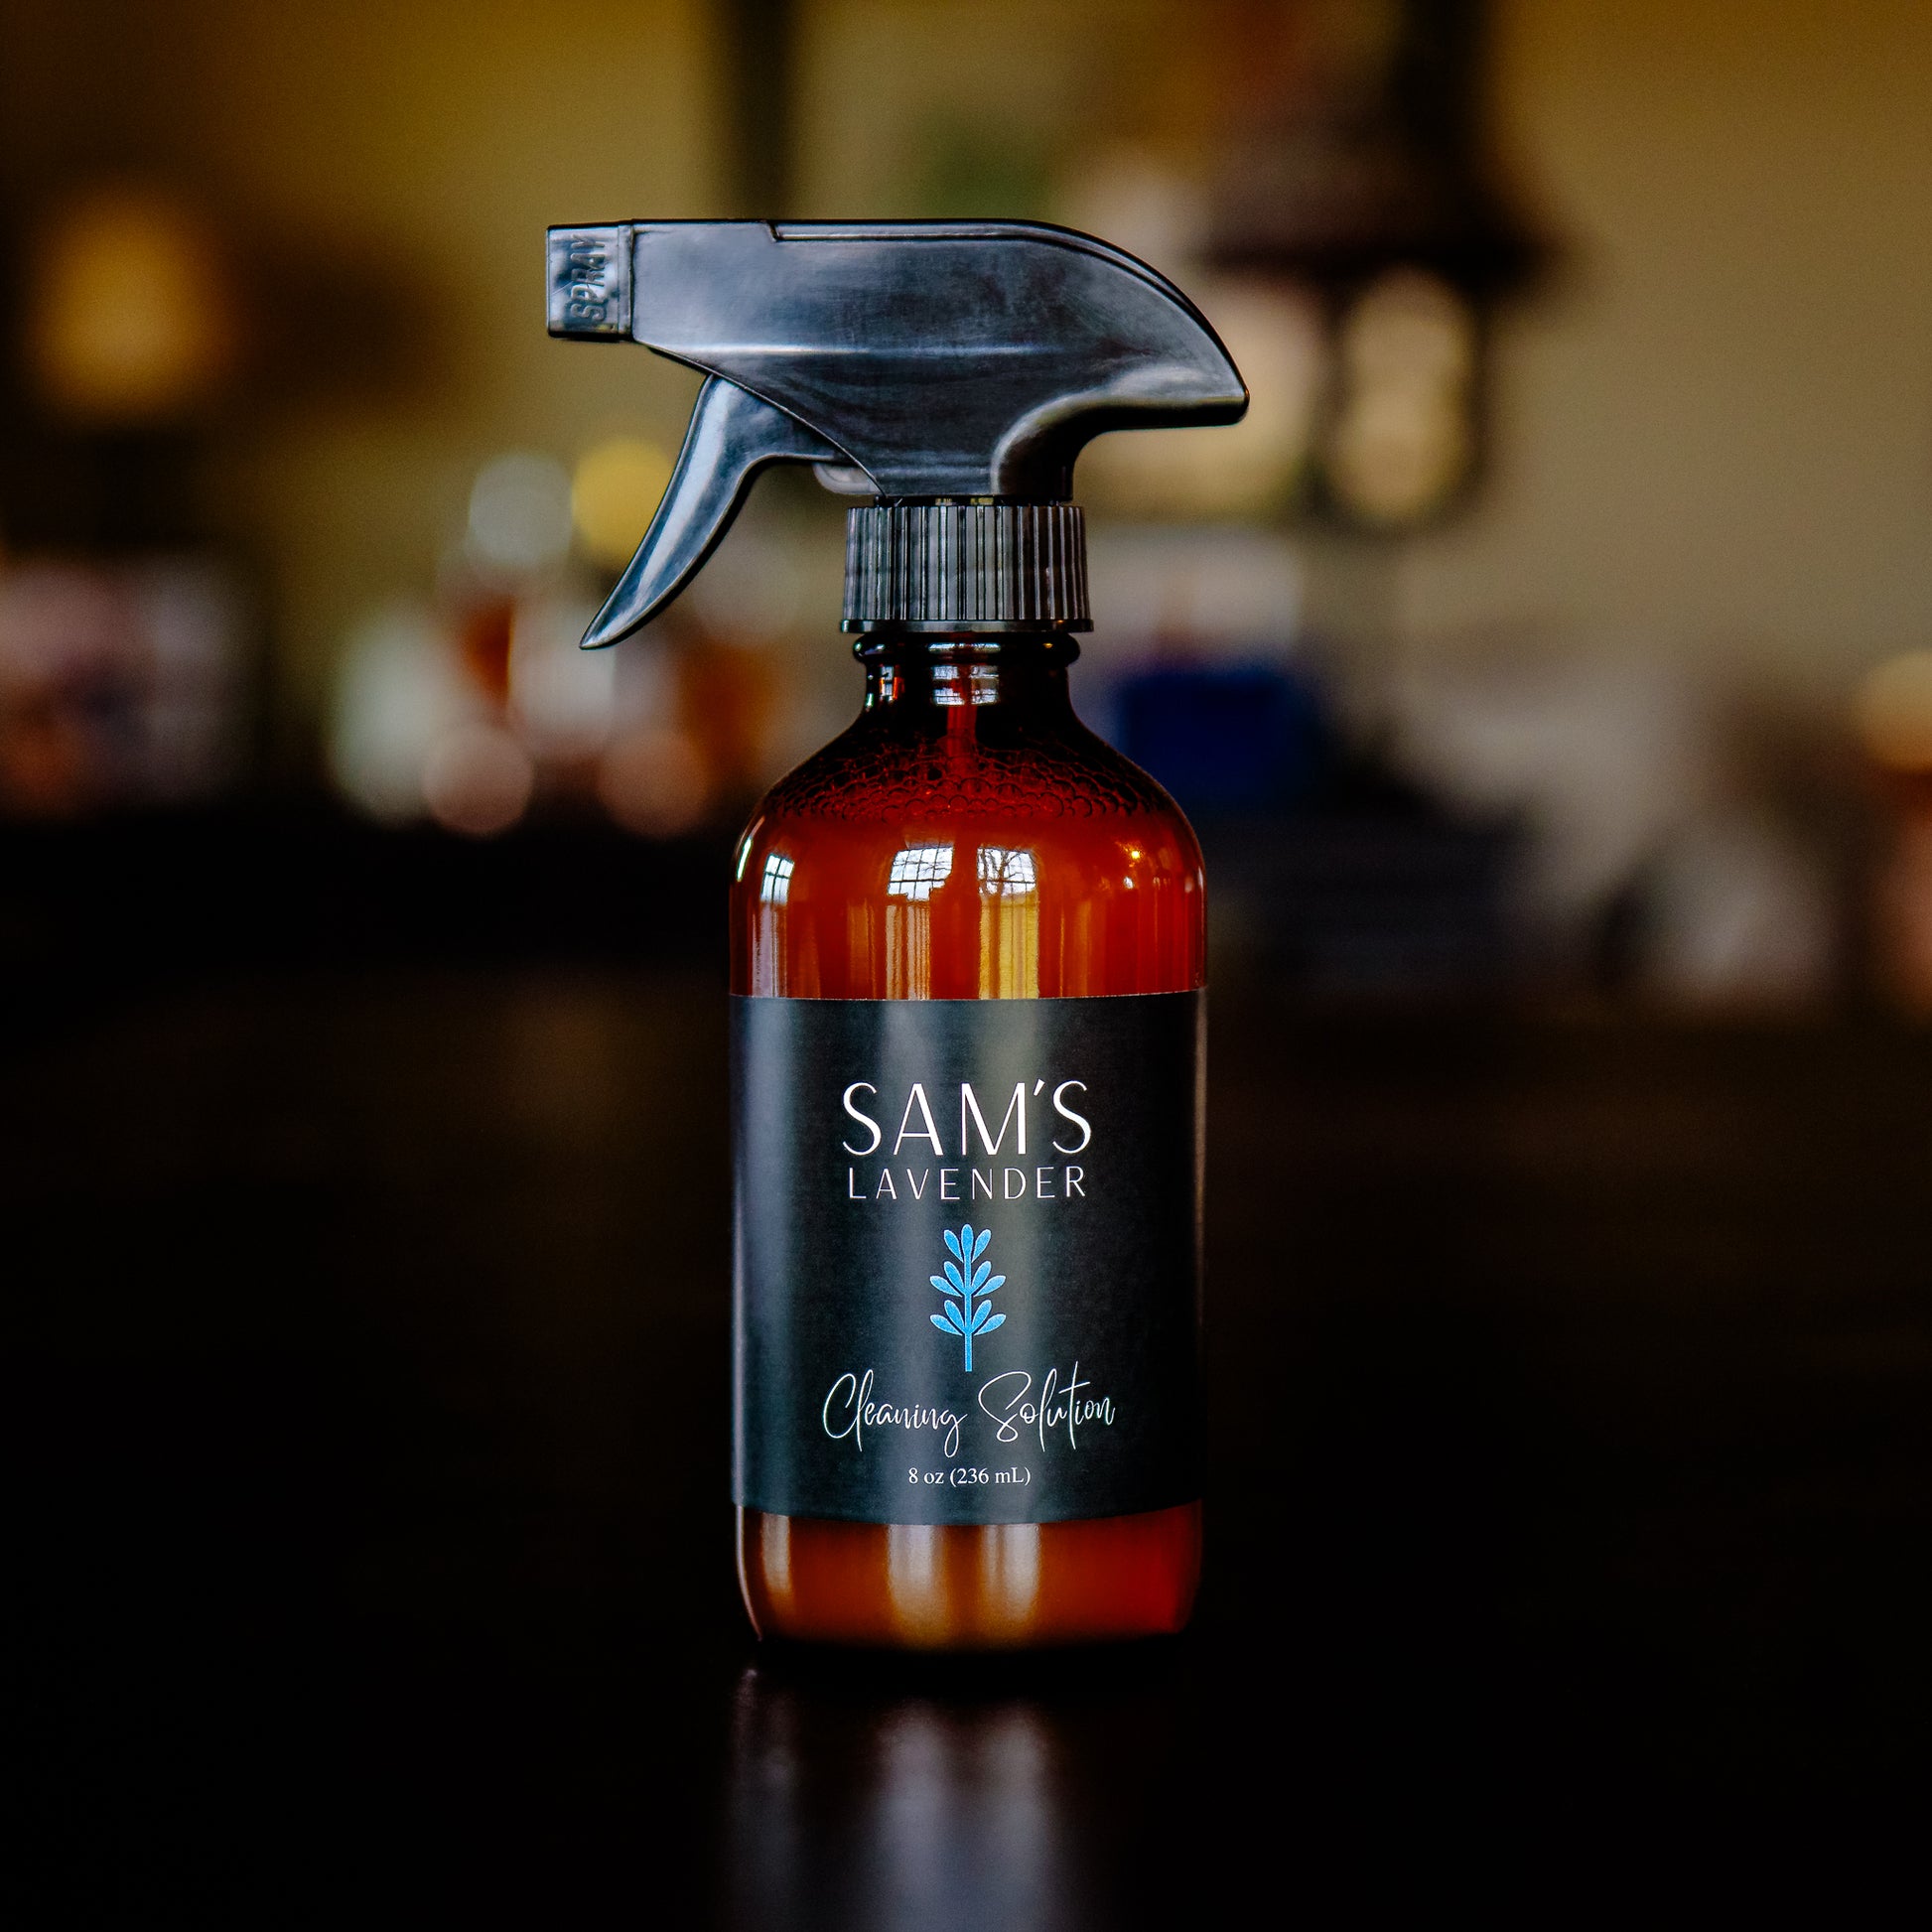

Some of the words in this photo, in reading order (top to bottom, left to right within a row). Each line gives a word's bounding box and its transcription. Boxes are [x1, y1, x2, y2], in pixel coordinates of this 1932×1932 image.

[570, 234, 607, 322] SPRAY
[842, 1078, 1092, 1157] SAM'S
[848, 1166, 1087, 1201] LAVENDER
[822, 1369, 967, 1458] Cleaning
[977, 1361, 1116, 1452] Solution
[907, 1468, 918, 1484] 8
[923, 1472, 944, 1485] oz
[949, 1467, 989, 1487] (236
[995, 1466, 1032, 1486] mL)
